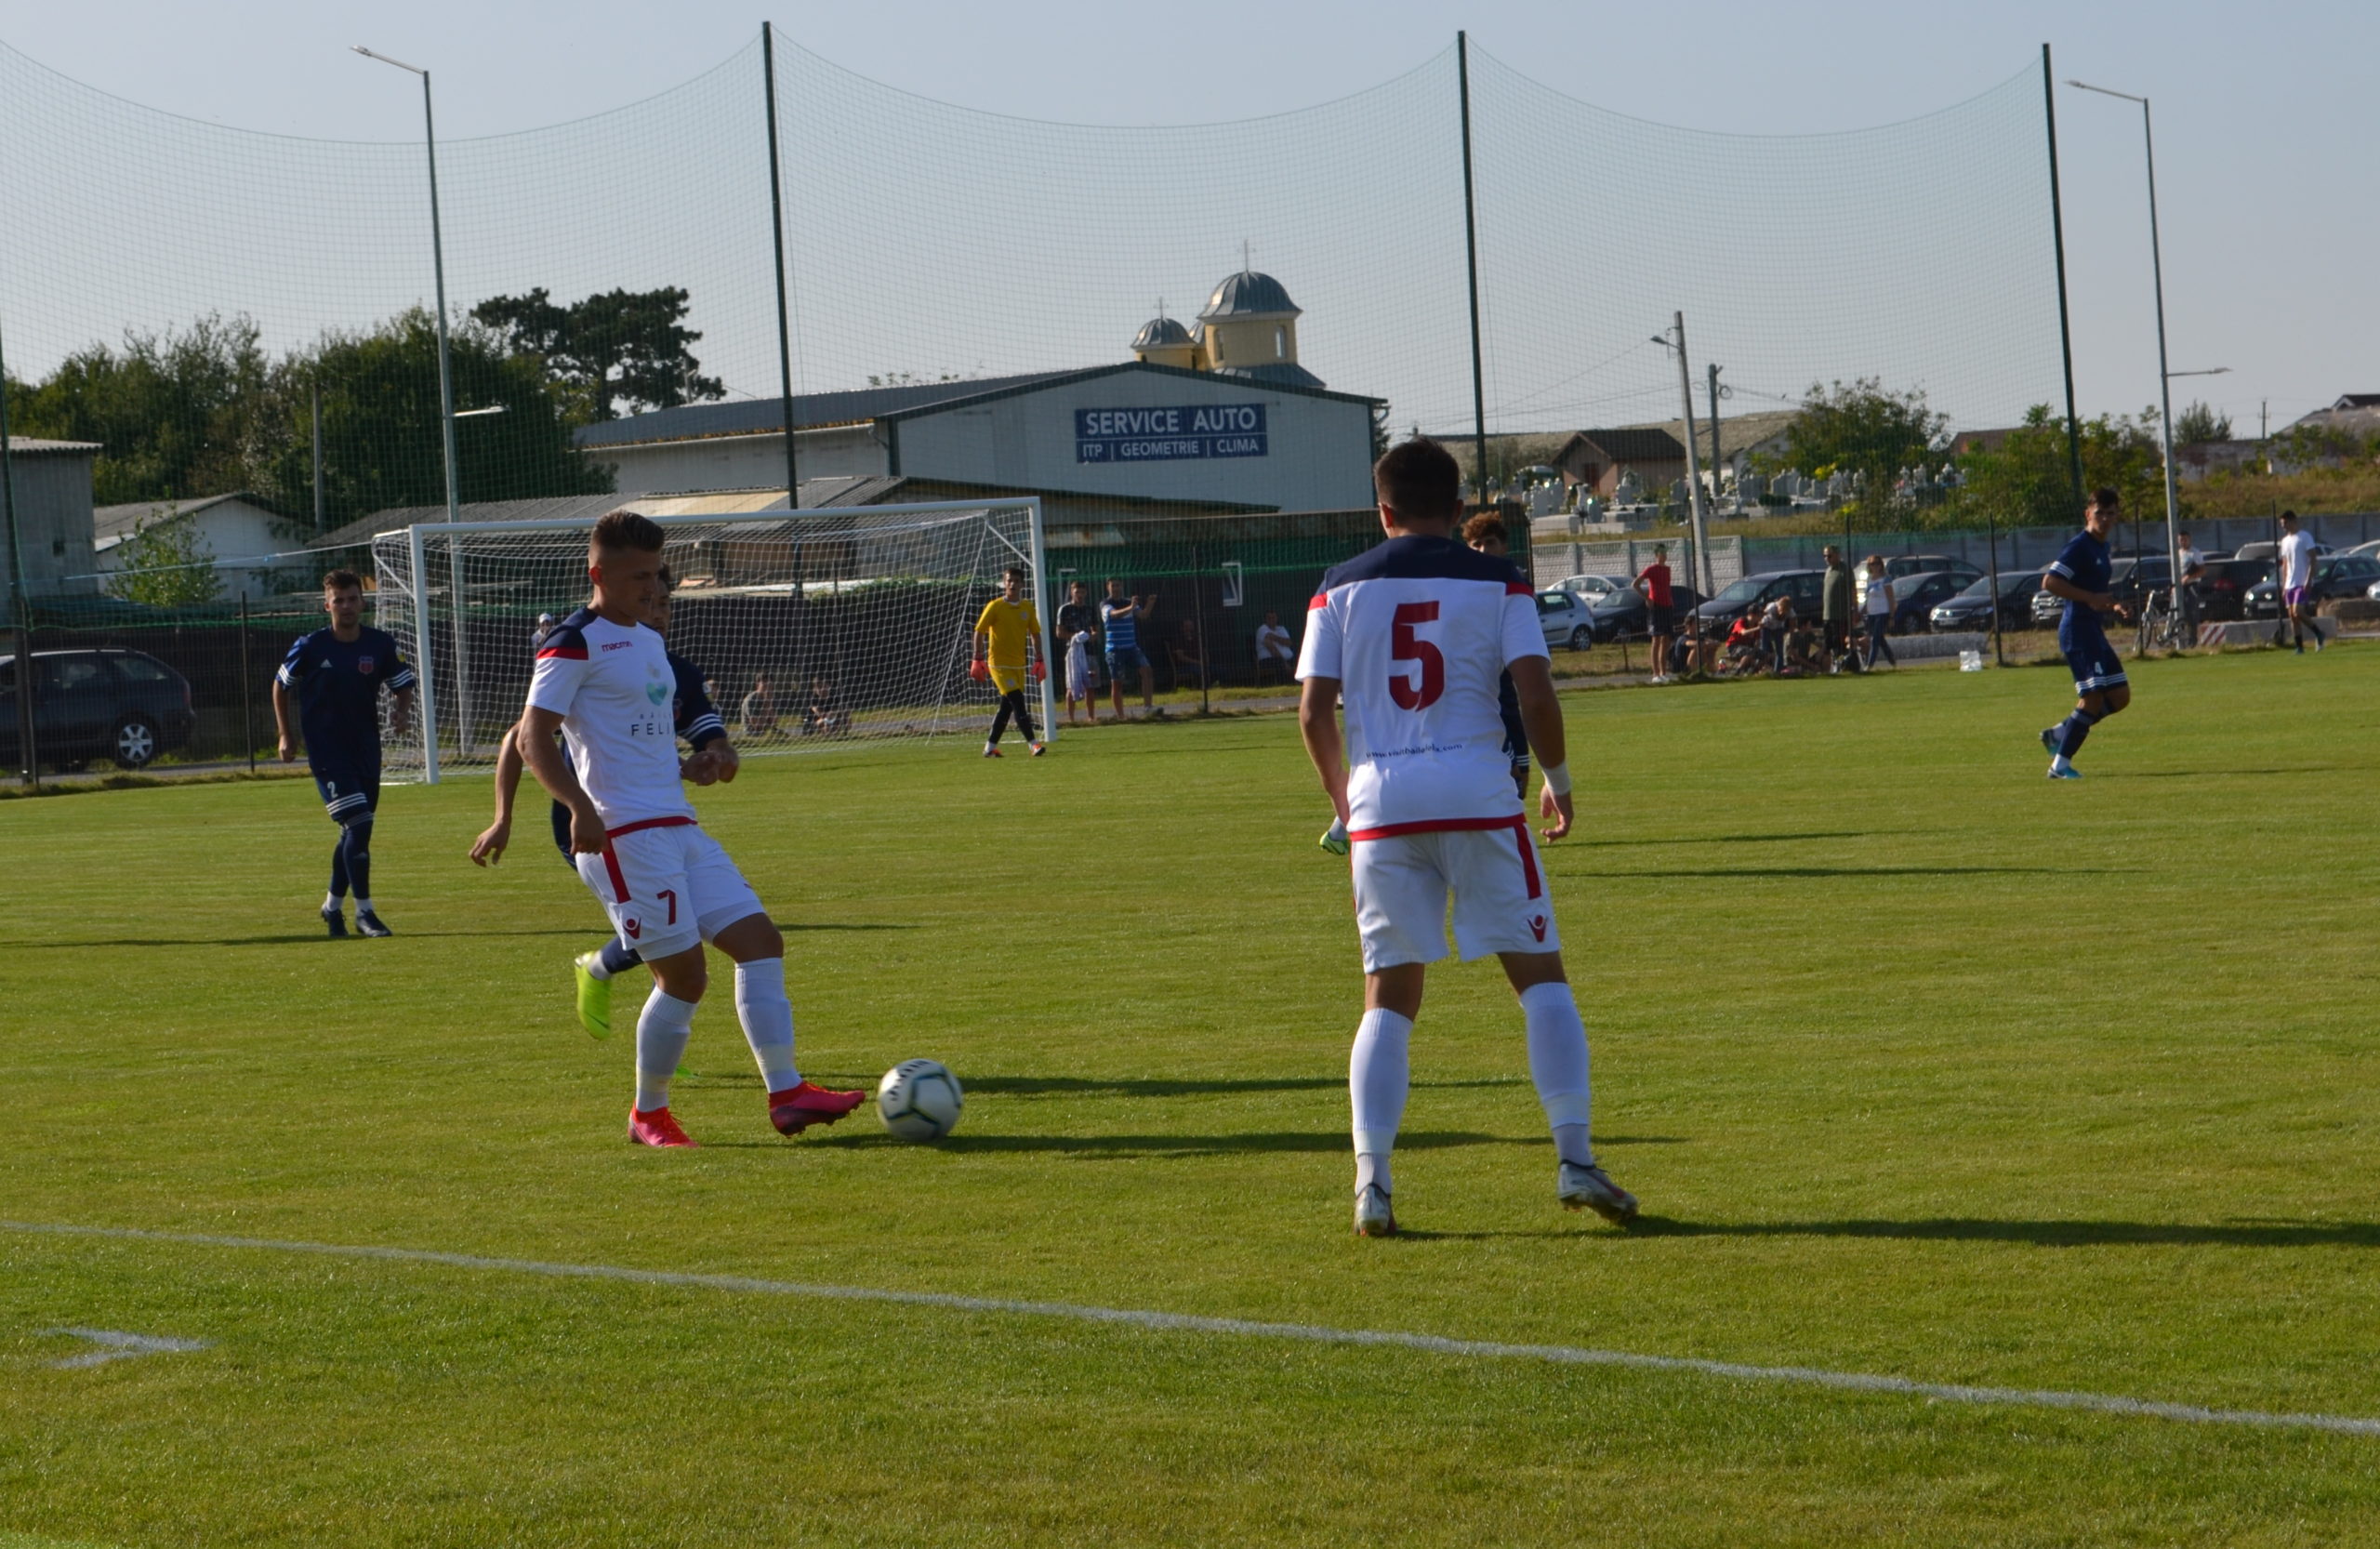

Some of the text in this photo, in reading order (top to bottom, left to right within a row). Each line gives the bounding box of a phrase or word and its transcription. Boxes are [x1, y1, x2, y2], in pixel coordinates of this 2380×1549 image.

[1086, 407, 1256, 435] SERVICE AUTO
[1083, 438, 1260, 458] ITP GEOMETRIE CLIMA
[1388, 600, 1445, 712] 5
[327, 781, 338, 799] 2
[656, 889, 676, 926] 7
